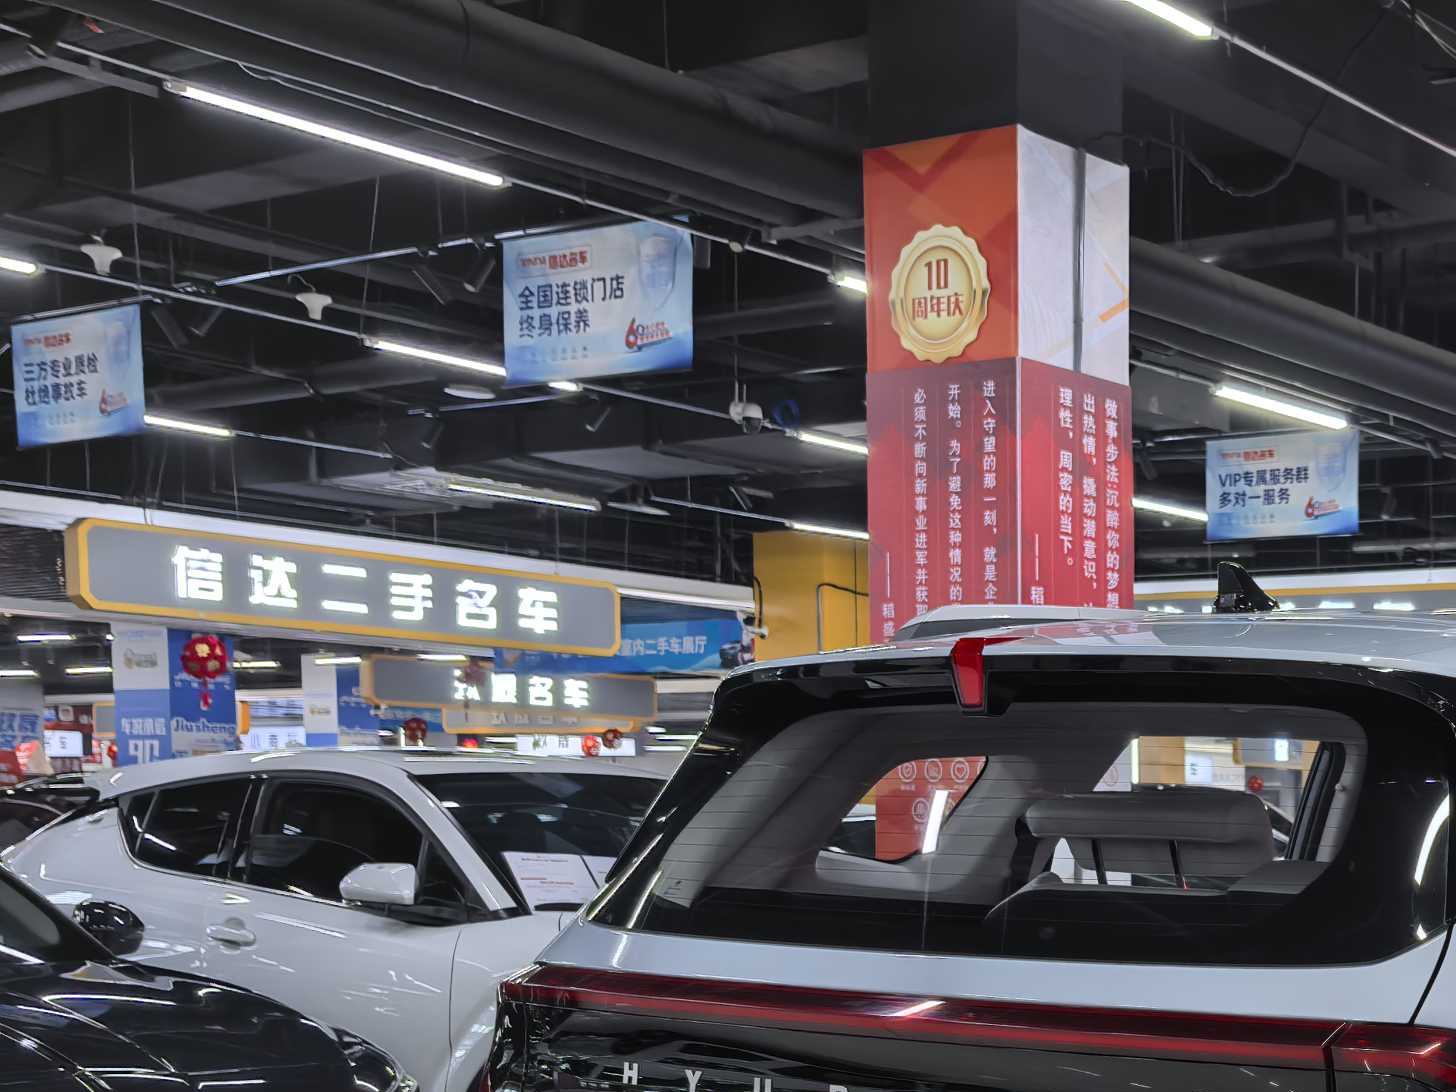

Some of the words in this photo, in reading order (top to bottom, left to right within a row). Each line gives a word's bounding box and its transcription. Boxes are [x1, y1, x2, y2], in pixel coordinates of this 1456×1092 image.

[924, 258, 949, 290] 10
[518, 274, 625, 311] 全国连锁门店
[911, 292, 964, 321] 周年庆
[518, 307, 590, 339] 终身保养
[983, 380, 999, 604] 进入守望的那一刻，就是企
[1218, 466, 1310, 488] VIP专属服务群
[948, 384, 962, 605] 开始。为了避免这种情况的
[1219, 488, 1291, 509] 多对一服务
[171, 545, 558, 633] 信达二手名车
